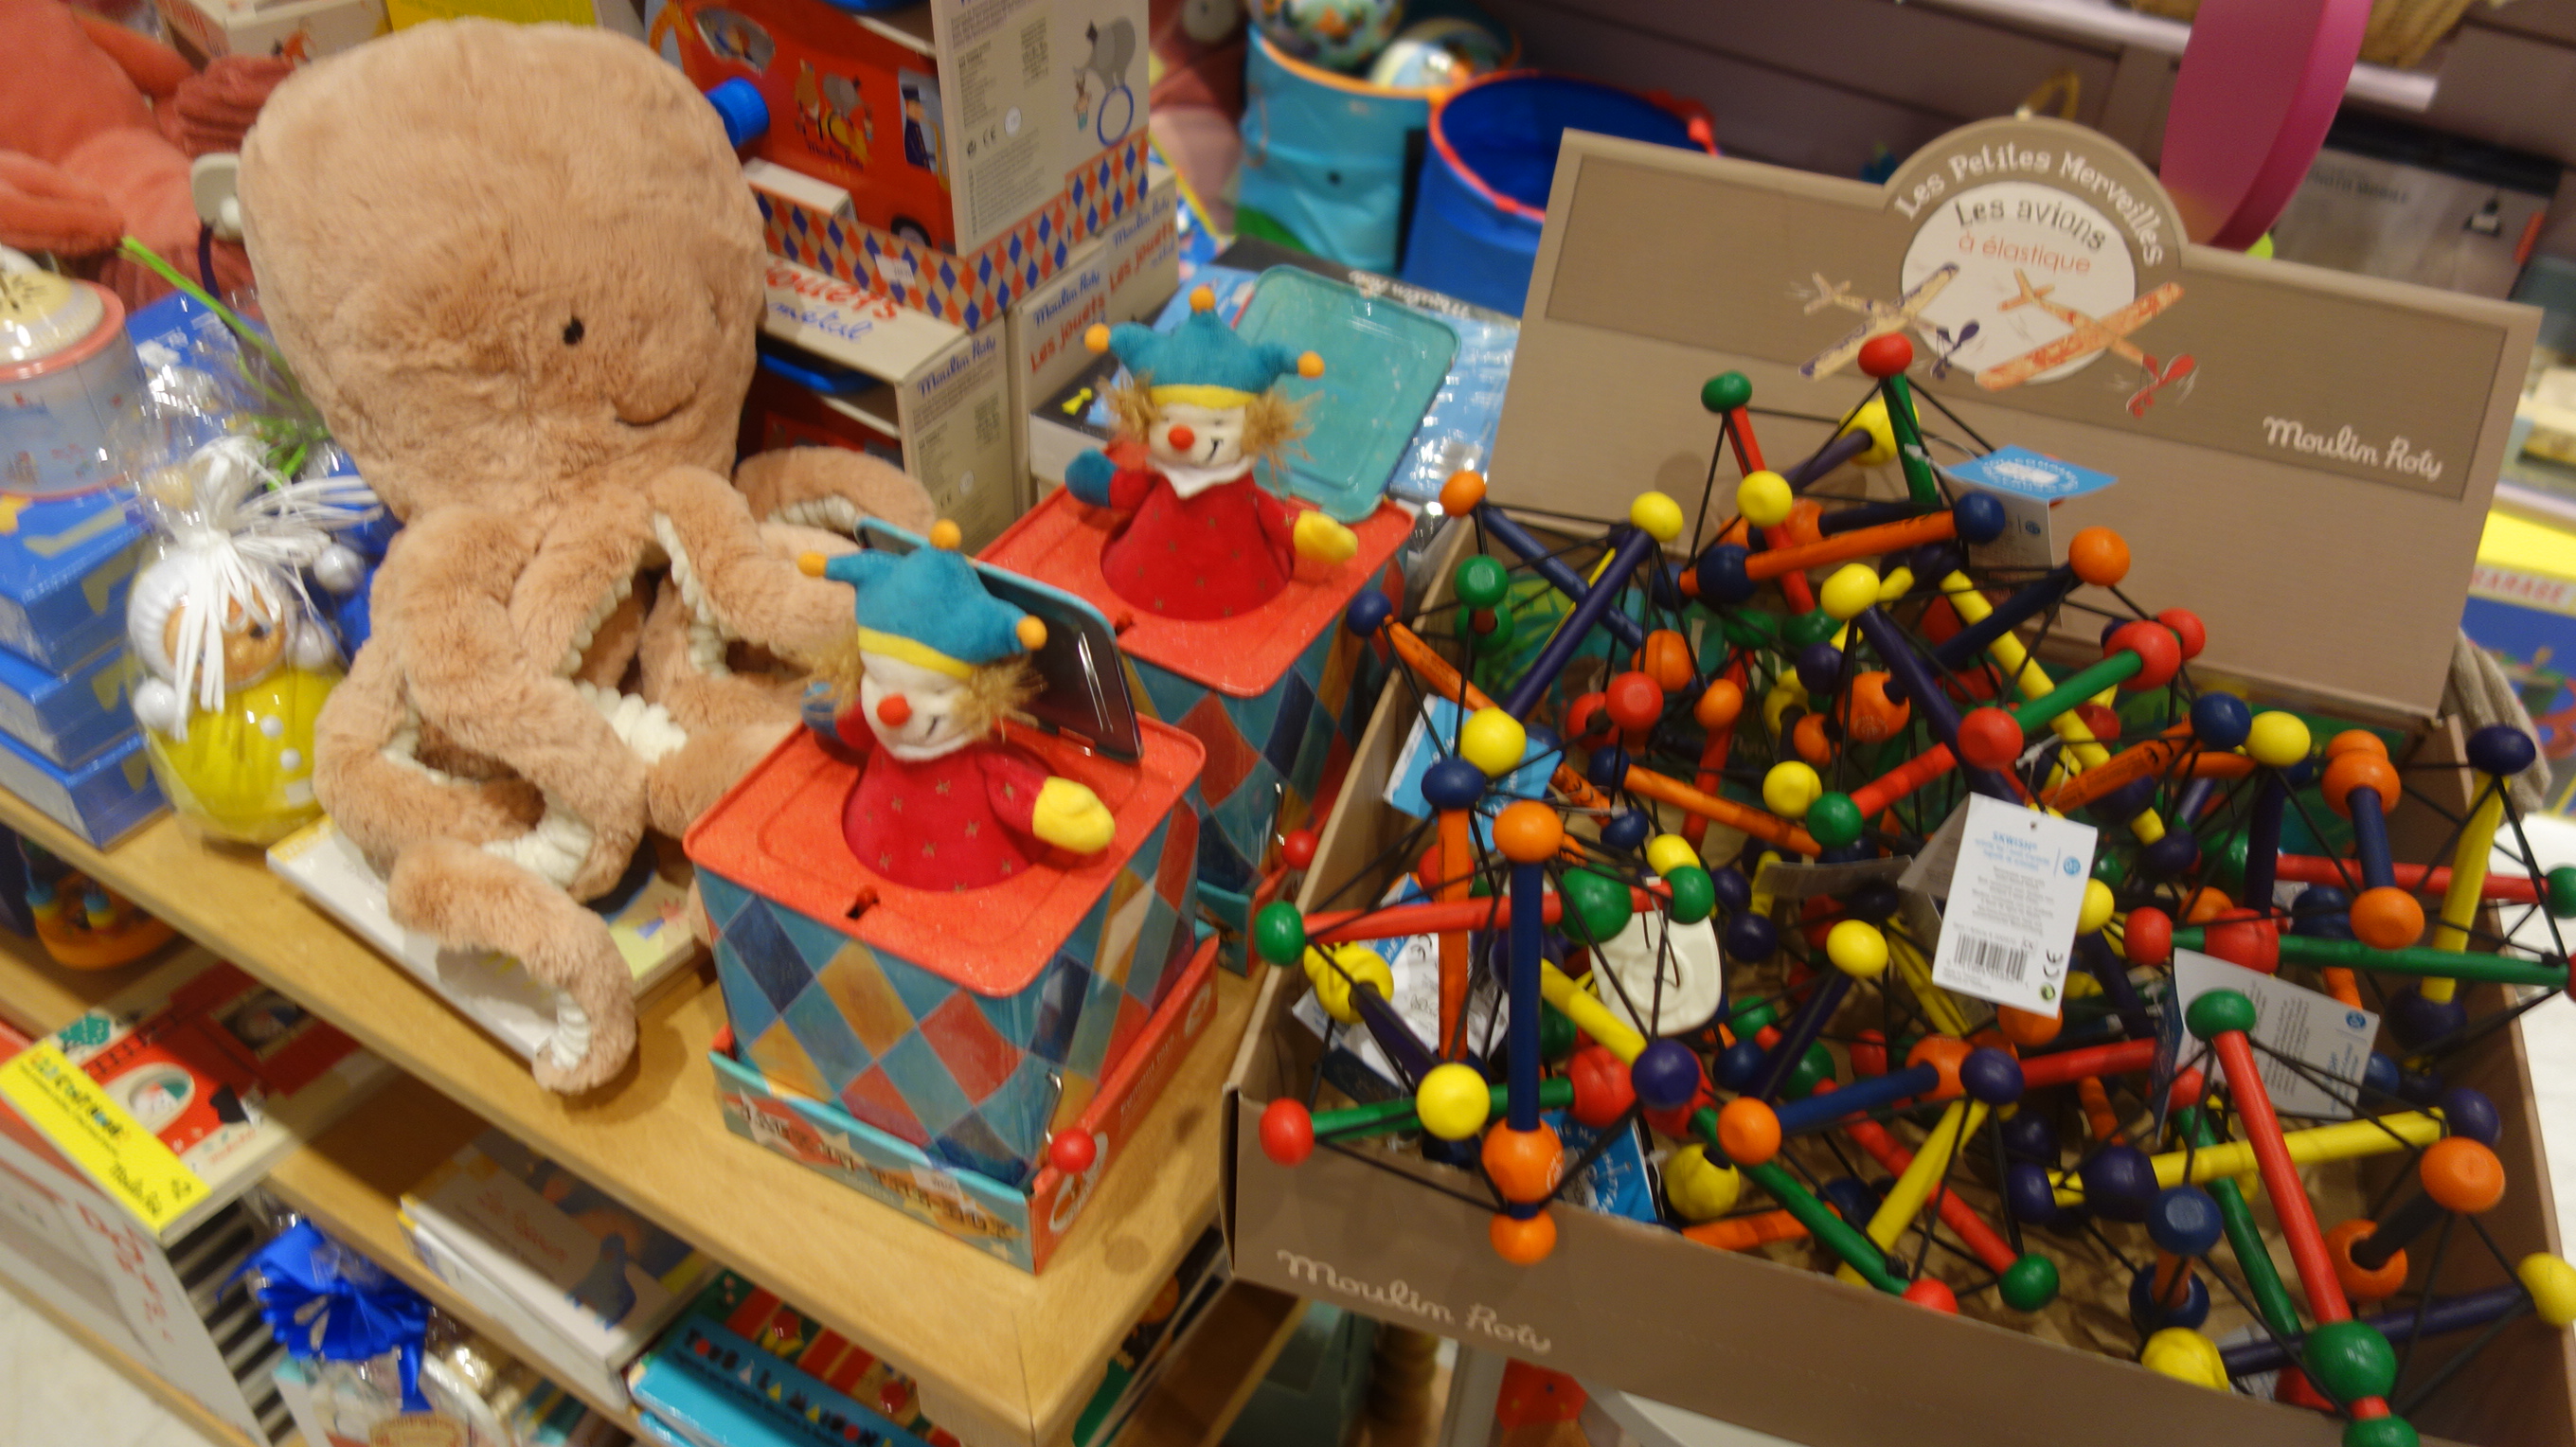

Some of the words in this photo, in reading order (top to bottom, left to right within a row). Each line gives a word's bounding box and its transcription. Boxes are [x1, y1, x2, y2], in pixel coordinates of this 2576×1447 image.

[1895, 173, 1945, 221] Les
[1948, 141, 2051, 184] Petites
[2059, 151, 2164, 267] Merveilles
[1955, 198, 2005, 228] Les
[2016, 199, 2106, 252] avions
[1958, 231, 1976, 255] à
[1981, 235, 2091, 275] élastique
[1030, 337, 1056, 374] Les
[1061, 293, 1106, 352] jouets
[1033, 287, 1078, 328] Moulin
[917, 354, 969, 398] Moulin
[971, 335, 996, 362] Roty
[2263, 415, 2380, 467] Moulin
[2384, 435, 2442, 482] Roty
[1277, 1249, 1457, 1326] Moulin
[1465, 1302, 1552, 1356] Roty
